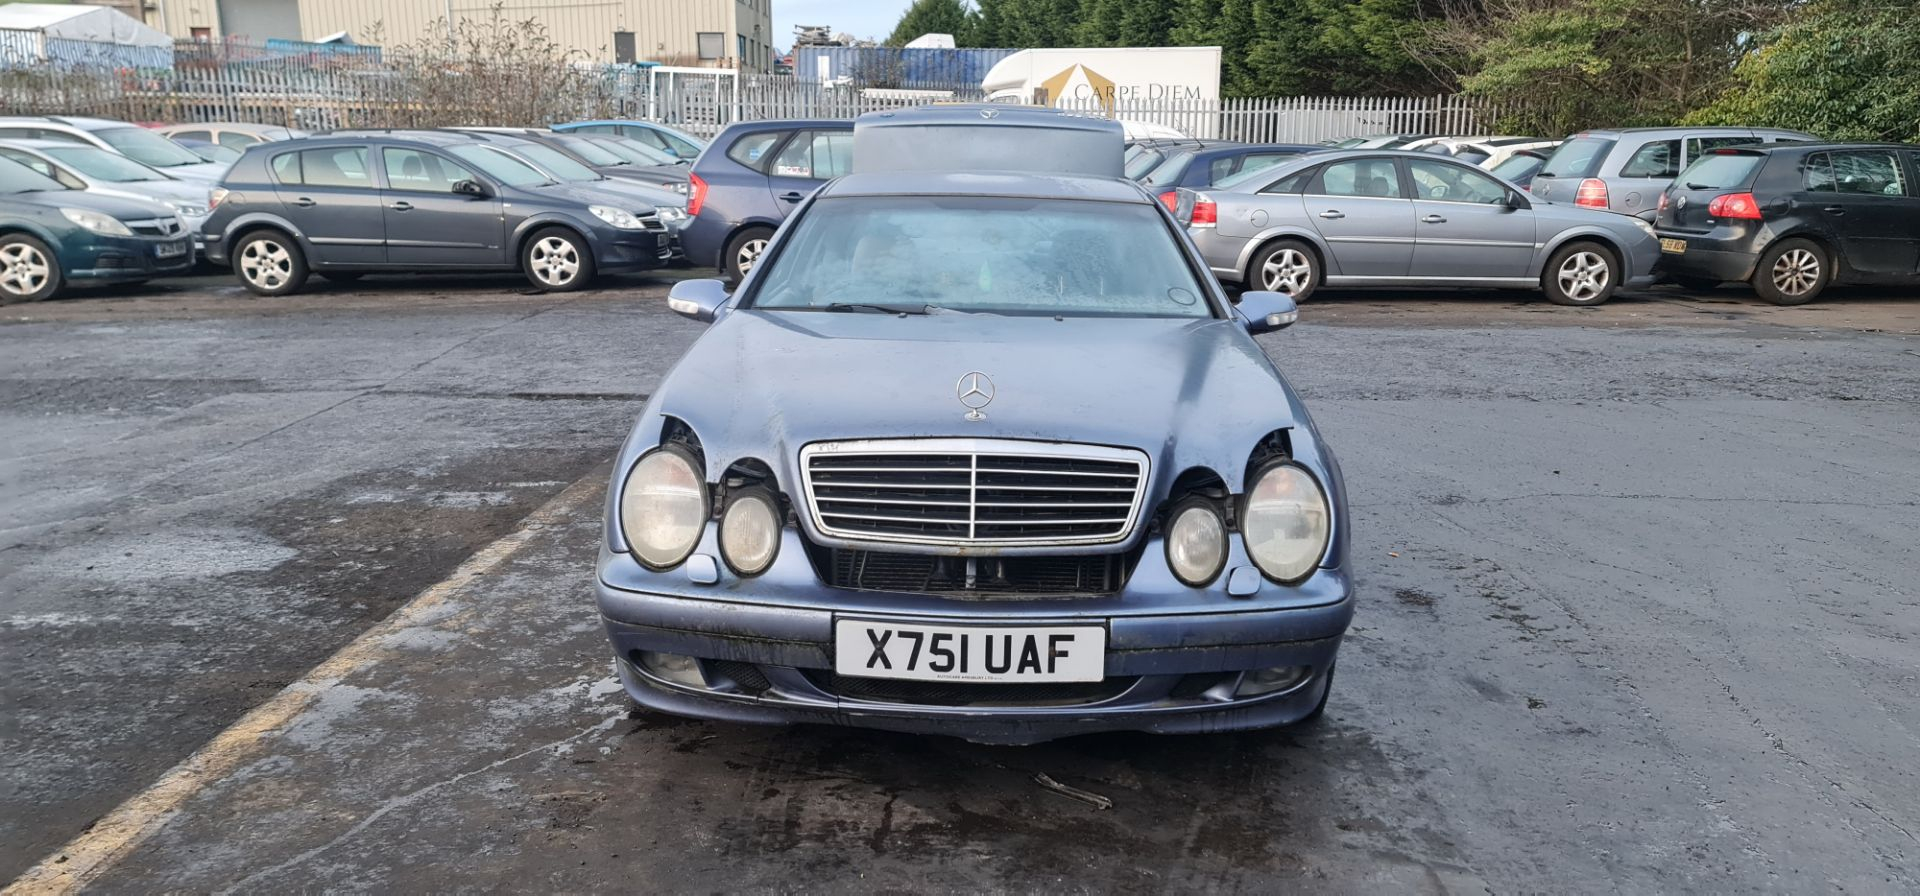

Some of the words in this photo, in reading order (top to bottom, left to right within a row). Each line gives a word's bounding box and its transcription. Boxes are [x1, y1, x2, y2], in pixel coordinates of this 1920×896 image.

[1074, 83, 1141, 101] CARPE
[1148, 83, 1201, 100] DIEM
[866, 628, 968, 673] X751
[984, 634, 1075, 674] UAF
